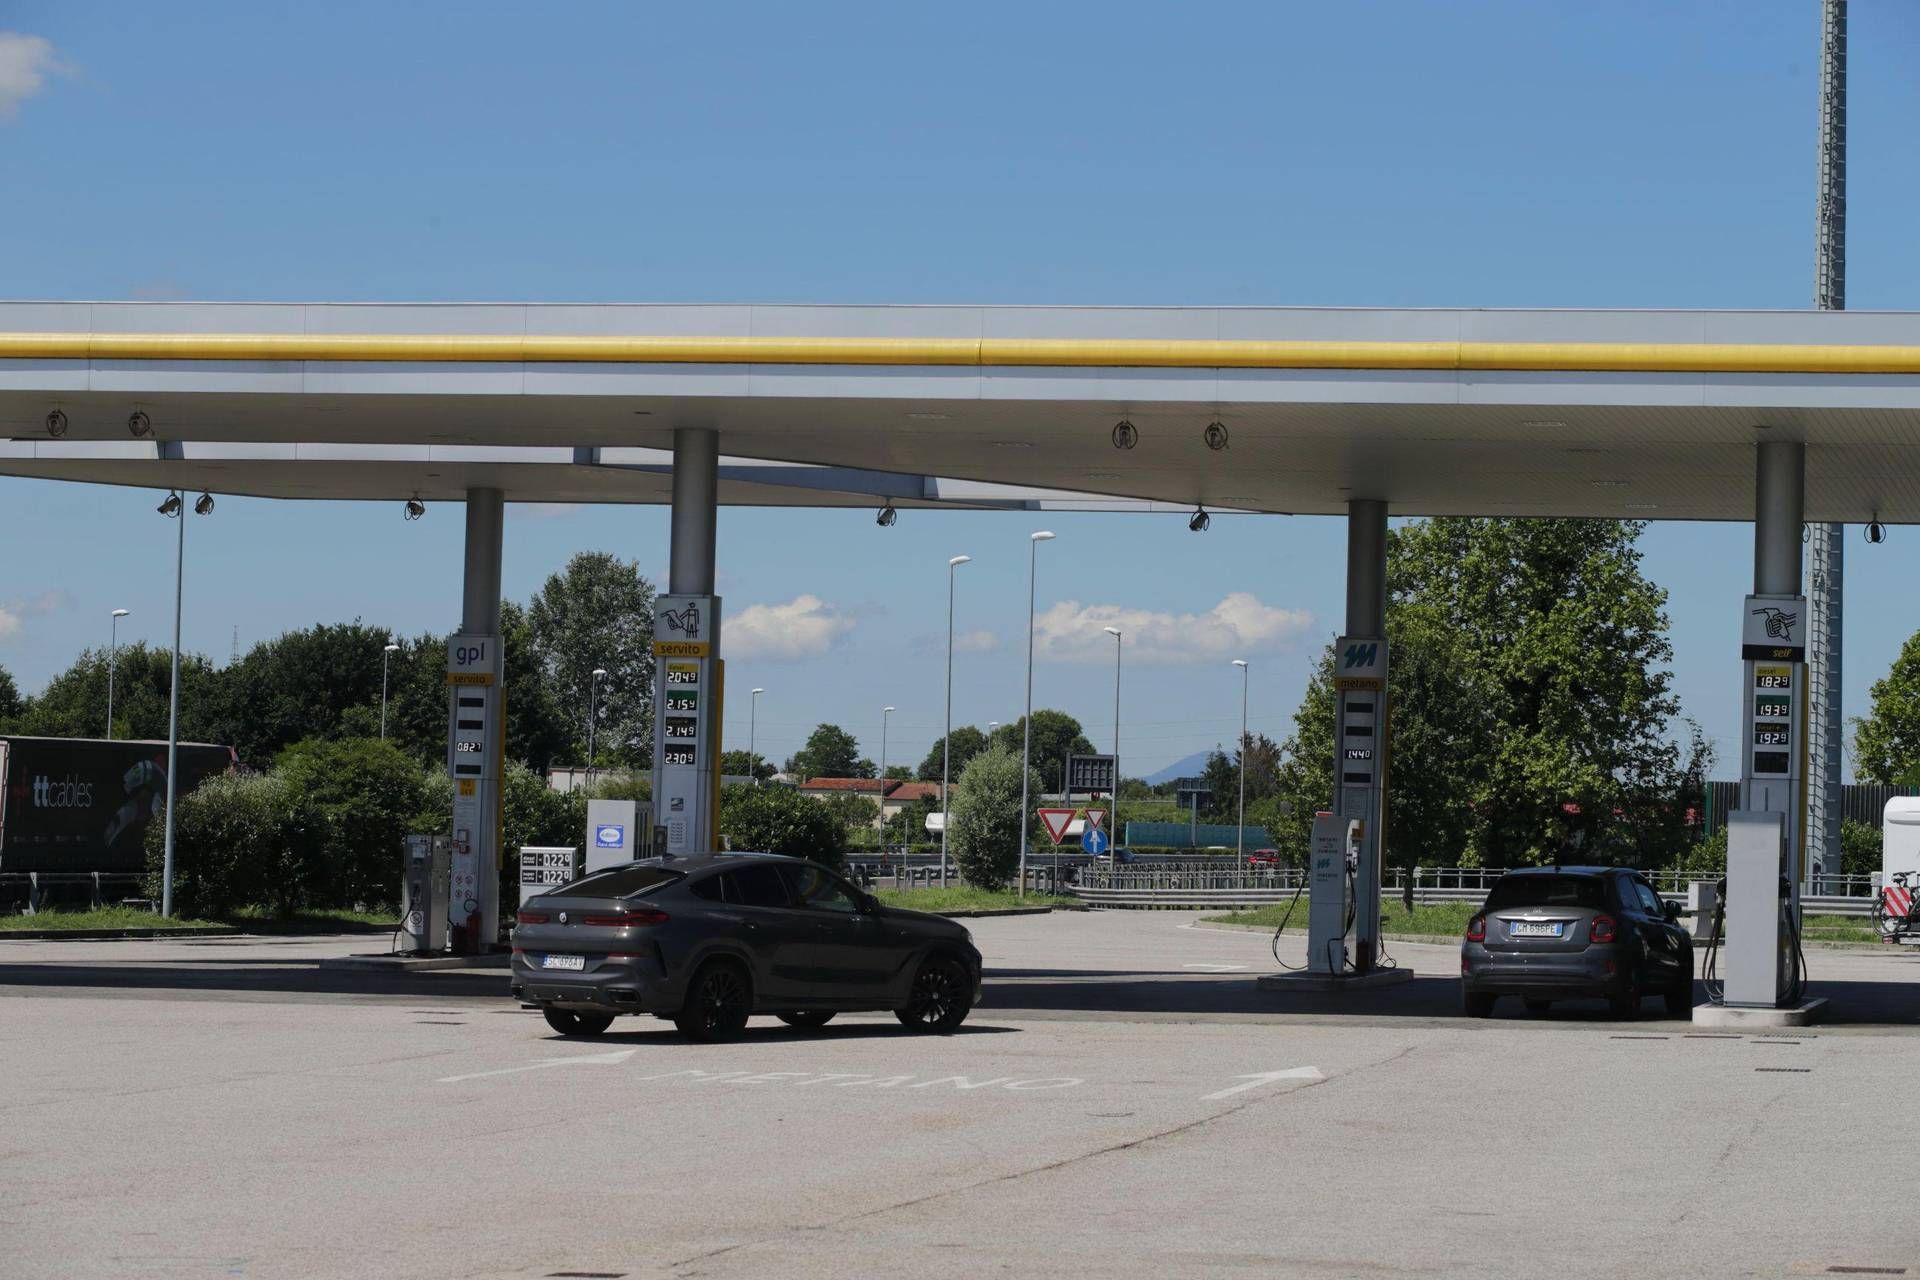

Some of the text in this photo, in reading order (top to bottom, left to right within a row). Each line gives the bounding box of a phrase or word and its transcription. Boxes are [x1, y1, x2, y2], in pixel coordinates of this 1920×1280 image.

[457, 642, 484, 665] gpl
[660, 643, 700, 655] servito
[1341, 679, 1378, 689] metano
[638, 1069, 1085, 1091] METANO
